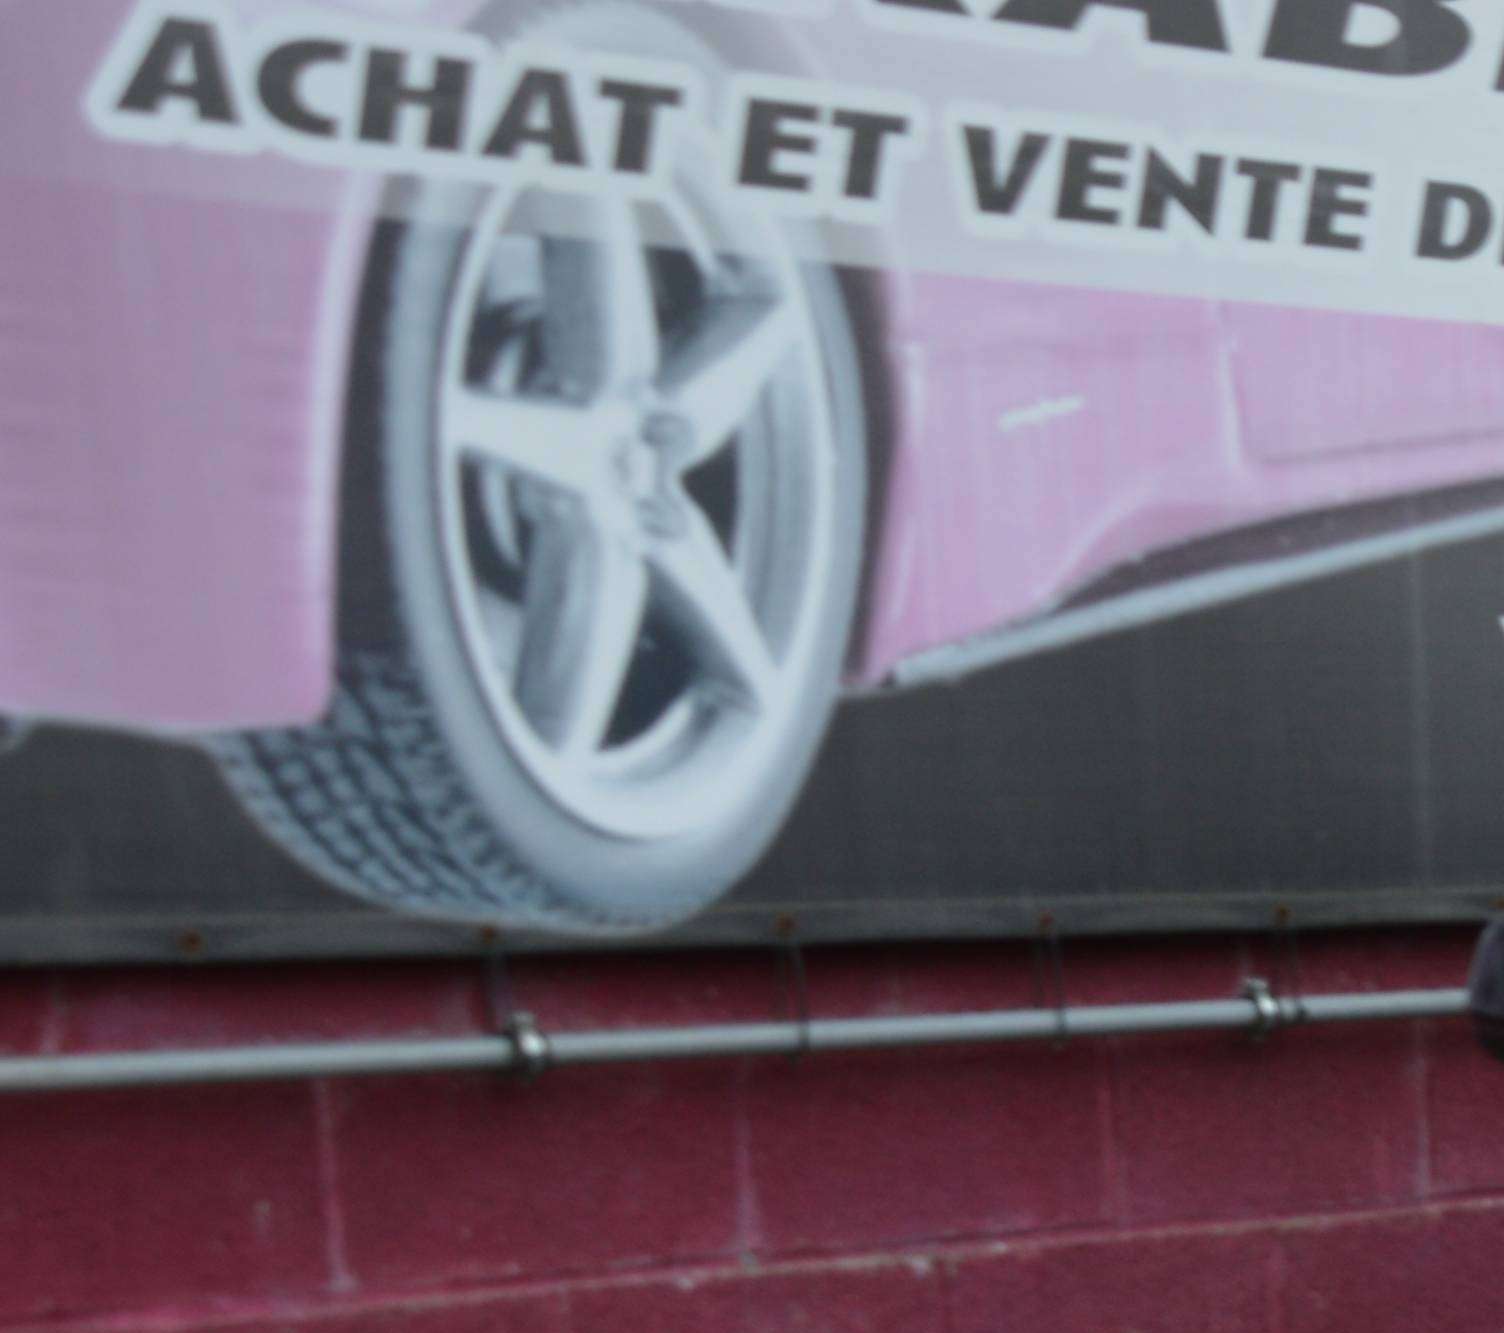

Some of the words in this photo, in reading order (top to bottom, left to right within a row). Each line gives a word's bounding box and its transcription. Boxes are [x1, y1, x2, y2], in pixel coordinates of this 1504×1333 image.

[115, 16, 682, 175] ACHAT
[736, 98, 908, 200] ET
[962, 124, 1372, 252] VENTE
